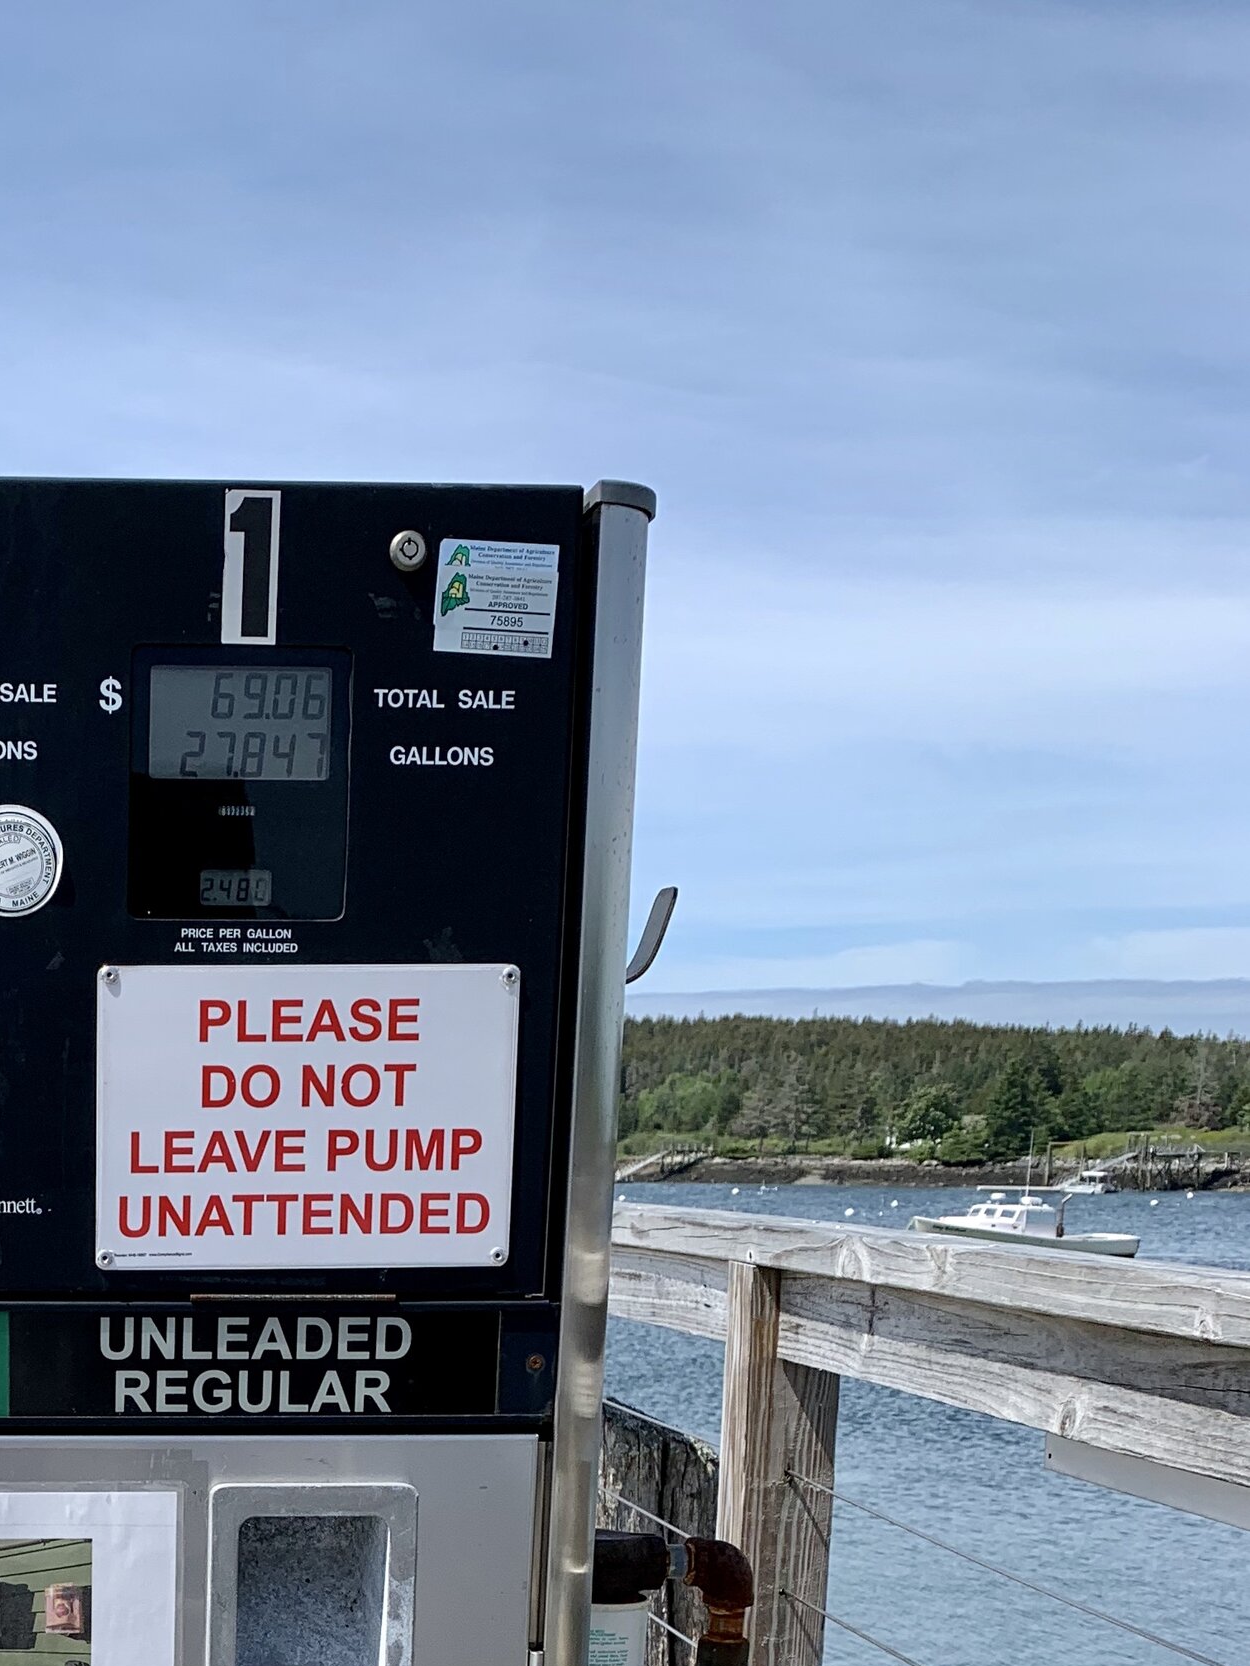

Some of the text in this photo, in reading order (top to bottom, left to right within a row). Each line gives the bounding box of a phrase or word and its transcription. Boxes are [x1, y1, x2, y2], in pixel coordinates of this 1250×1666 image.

[228, 496, 274, 638] 1
[488, 601, 529, 610] APPROVED
[490, 615, 524, 627] 75895
[0, 683, 57, 704] SALE
[98, 676, 123, 714] $
[211, 672, 326, 720] 69.06
[373, 689, 515, 710] TOTAL SALE
[179, 730, 327, 778] 27.847
[389, 746, 495, 768] GALLONS
[26, 828, 52, 884] DEPARTMENT
[12, 891, 40, 907] MAINE
[174, 942, 298, 954] ALL TAXES INCLUDED
[181, 928, 292, 940] PRICE PER GALLON
[199, 998, 420, 1043] PLEASE
[201, 1063, 417, 1109] DO NOT
[130, 1128, 483, 1174] LEAVE PUMP
[118, 1192, 491, 1238] UNATTENDED
[99, 1316, 412, 1361] UNLEADED
[114, 1369, 392, 1414] REGULAR
